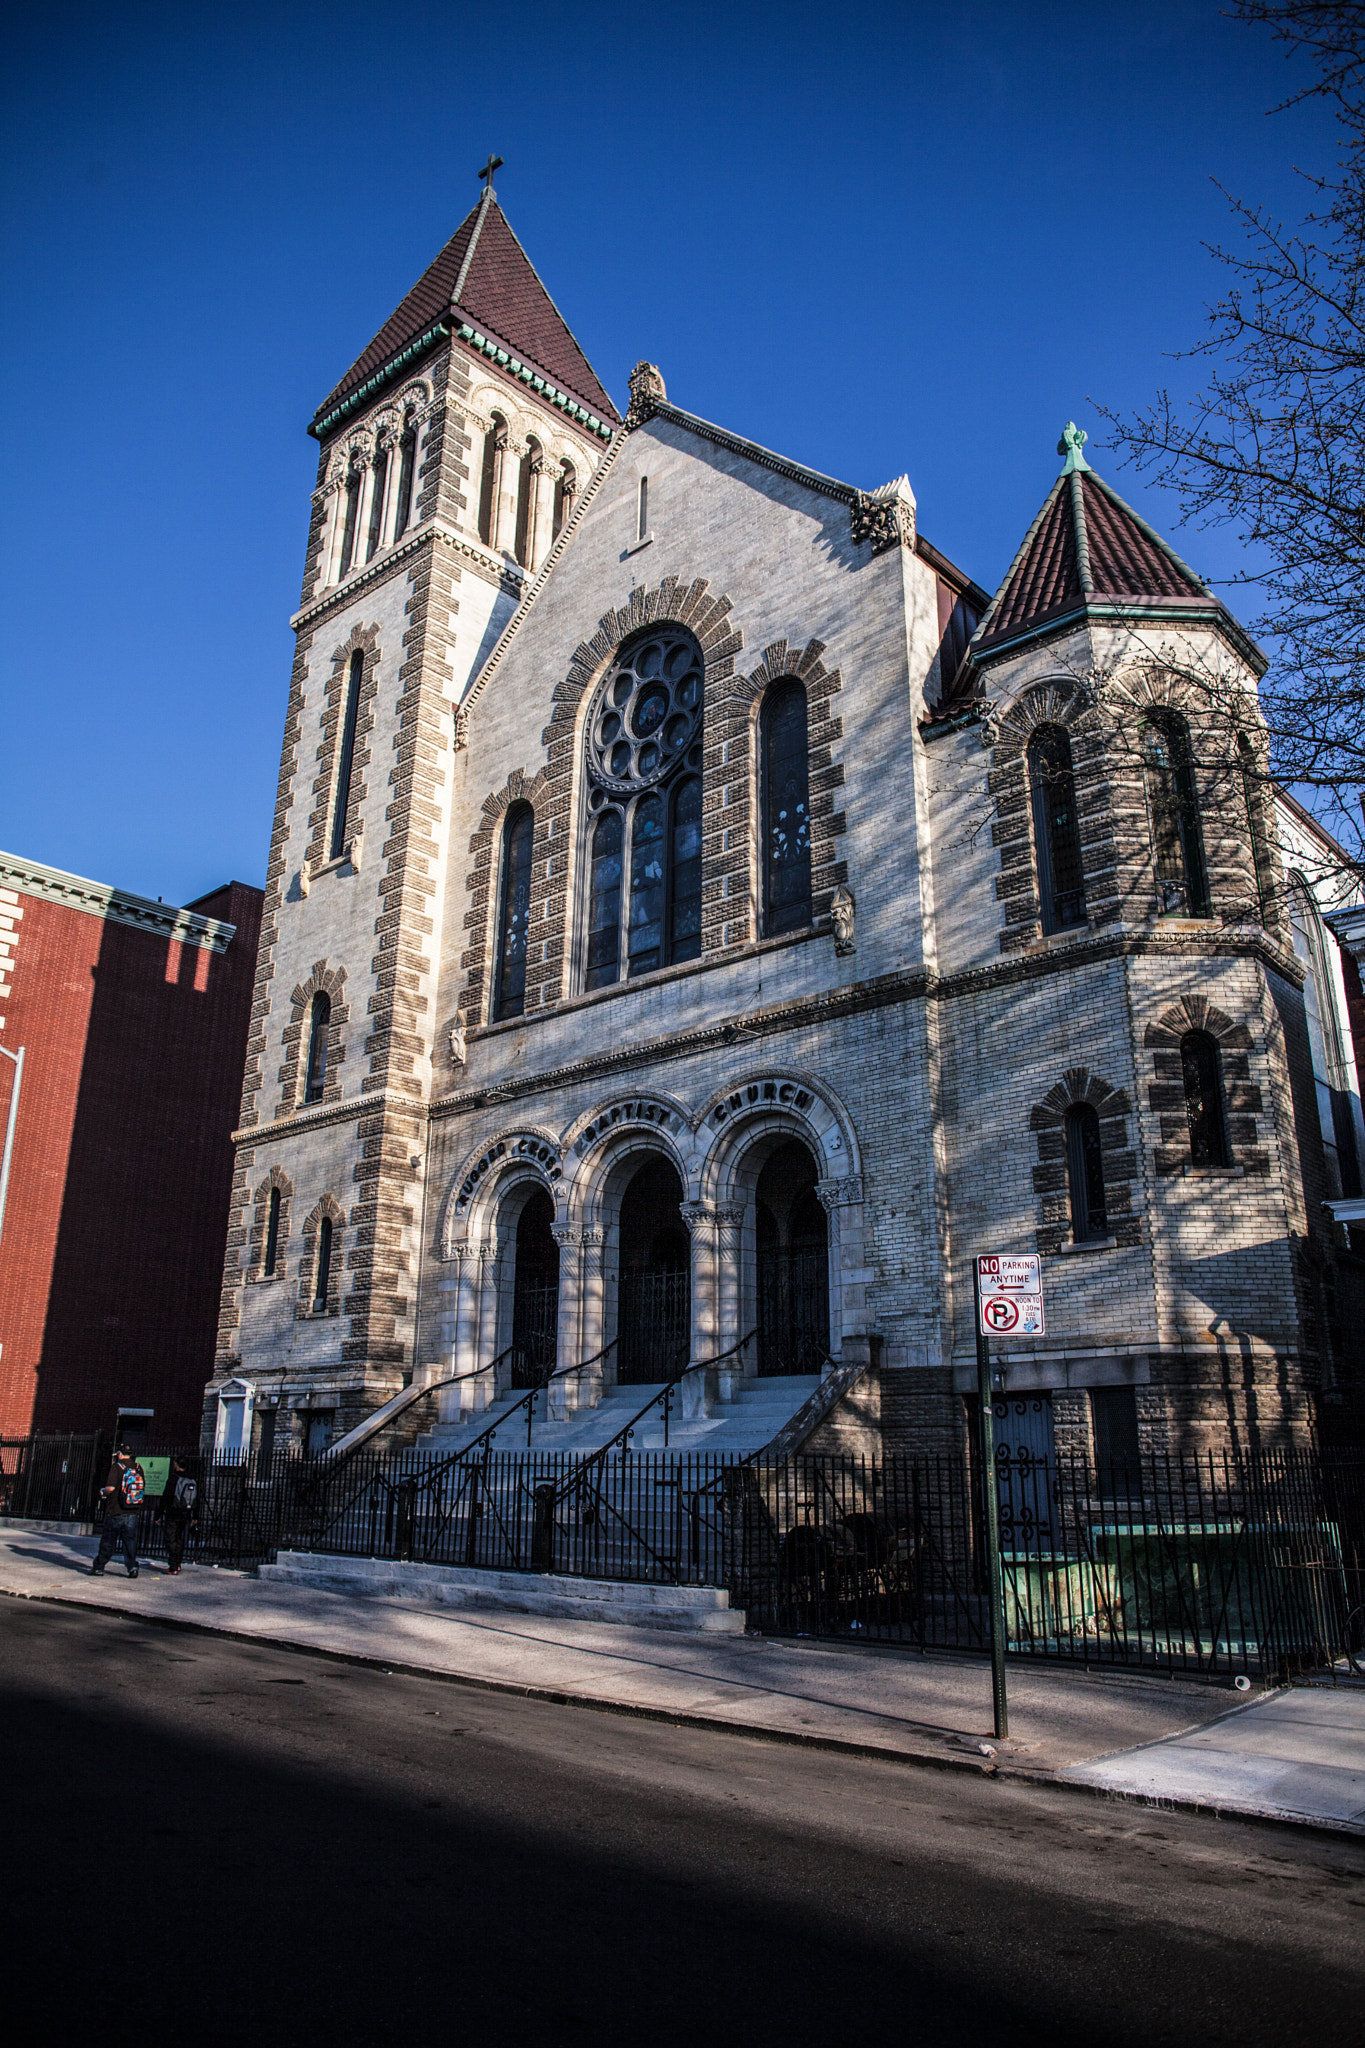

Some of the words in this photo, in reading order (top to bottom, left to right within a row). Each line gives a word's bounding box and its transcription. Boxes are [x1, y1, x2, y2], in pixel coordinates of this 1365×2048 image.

[714, 1083, 809, 1120] CHURCH
[585, 1103, 669, 1141] BAPTIST
[458, 1142, 505, 1206] RUGGED
[519, 1140, 562, 1181] CROSS
[980, 1259, 998, 1273] NO
[1002, 1261, 1035, 1269] PARKING
[990, 1275, 1030, 1283] ANYTIME
